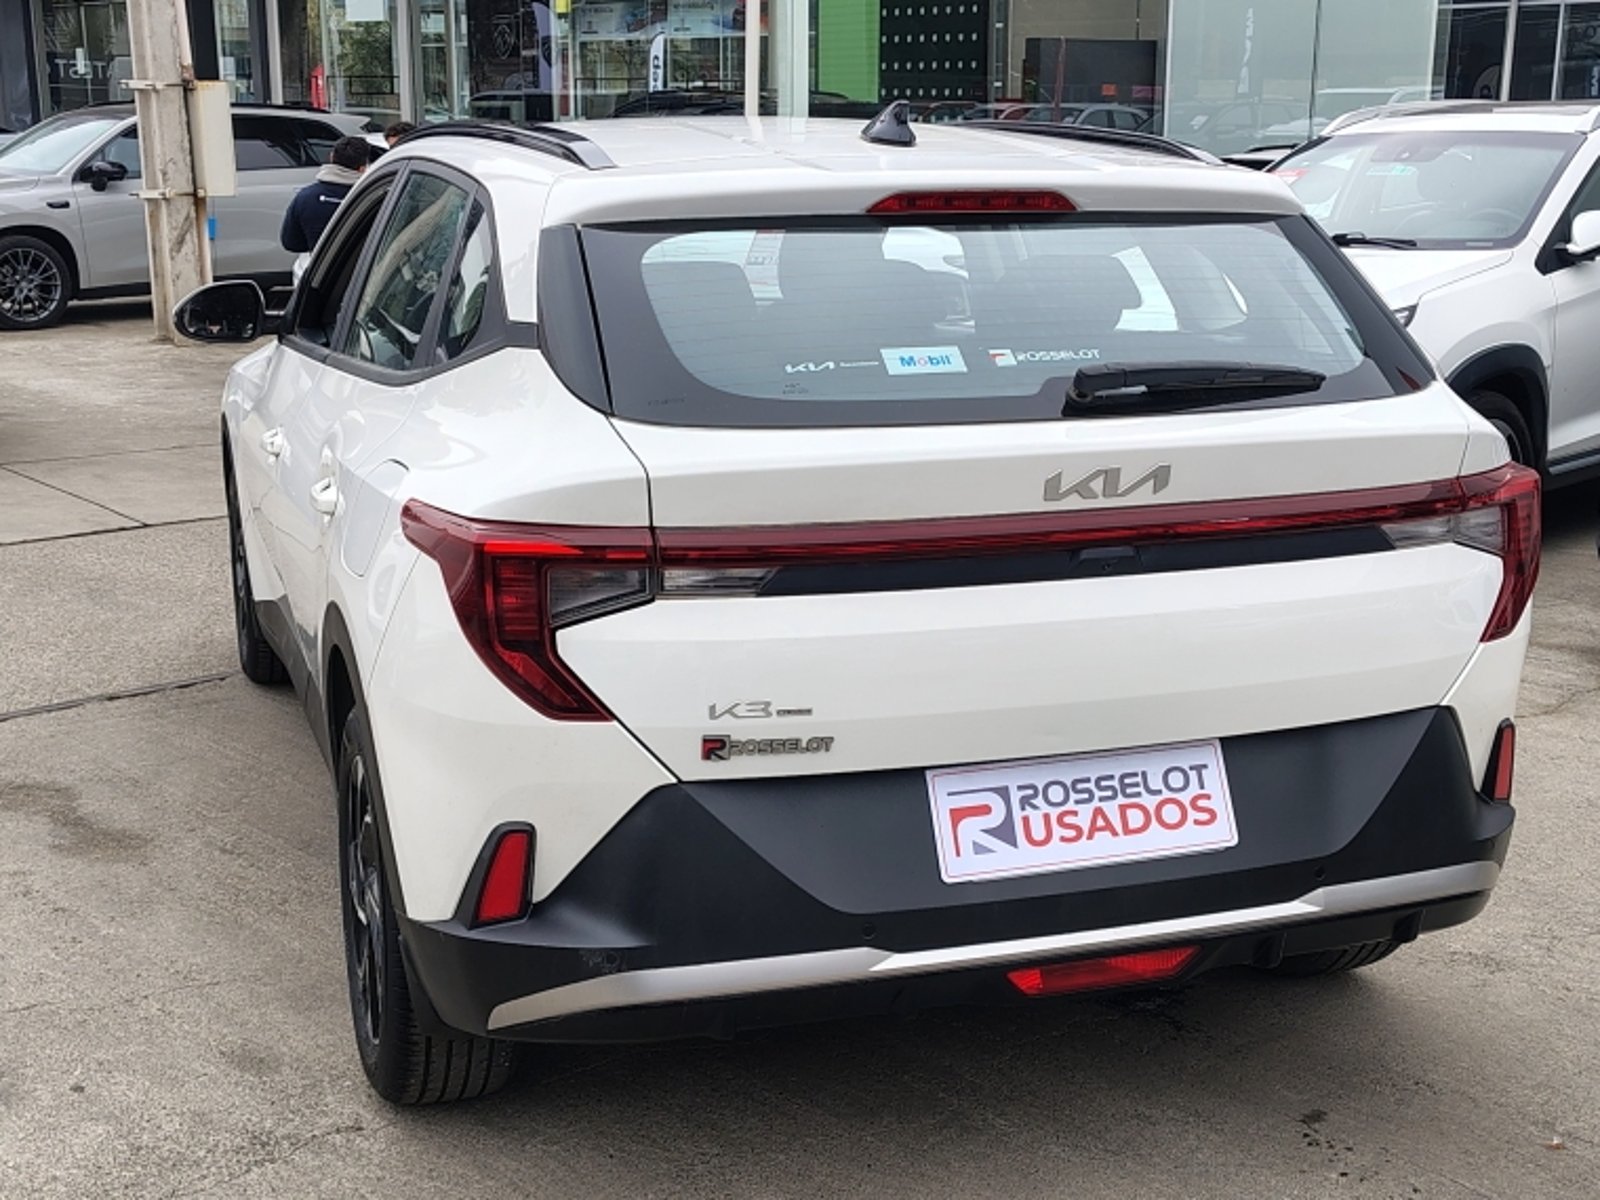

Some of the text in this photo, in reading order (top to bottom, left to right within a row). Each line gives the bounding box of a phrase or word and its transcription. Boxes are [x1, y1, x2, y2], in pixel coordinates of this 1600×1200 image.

[899, 354, 952, 368] Mobil
[1016, 348, 1101, 362] ROSSELOT
[784, 361, 835, 374] KIA
[1043, 462, 1171, 502] KIA
[709, 699, 773, 721] K3
[1016, 763, 1209, 811] ROSSELOT
[1020, 793, 1218, 848] USADOS
